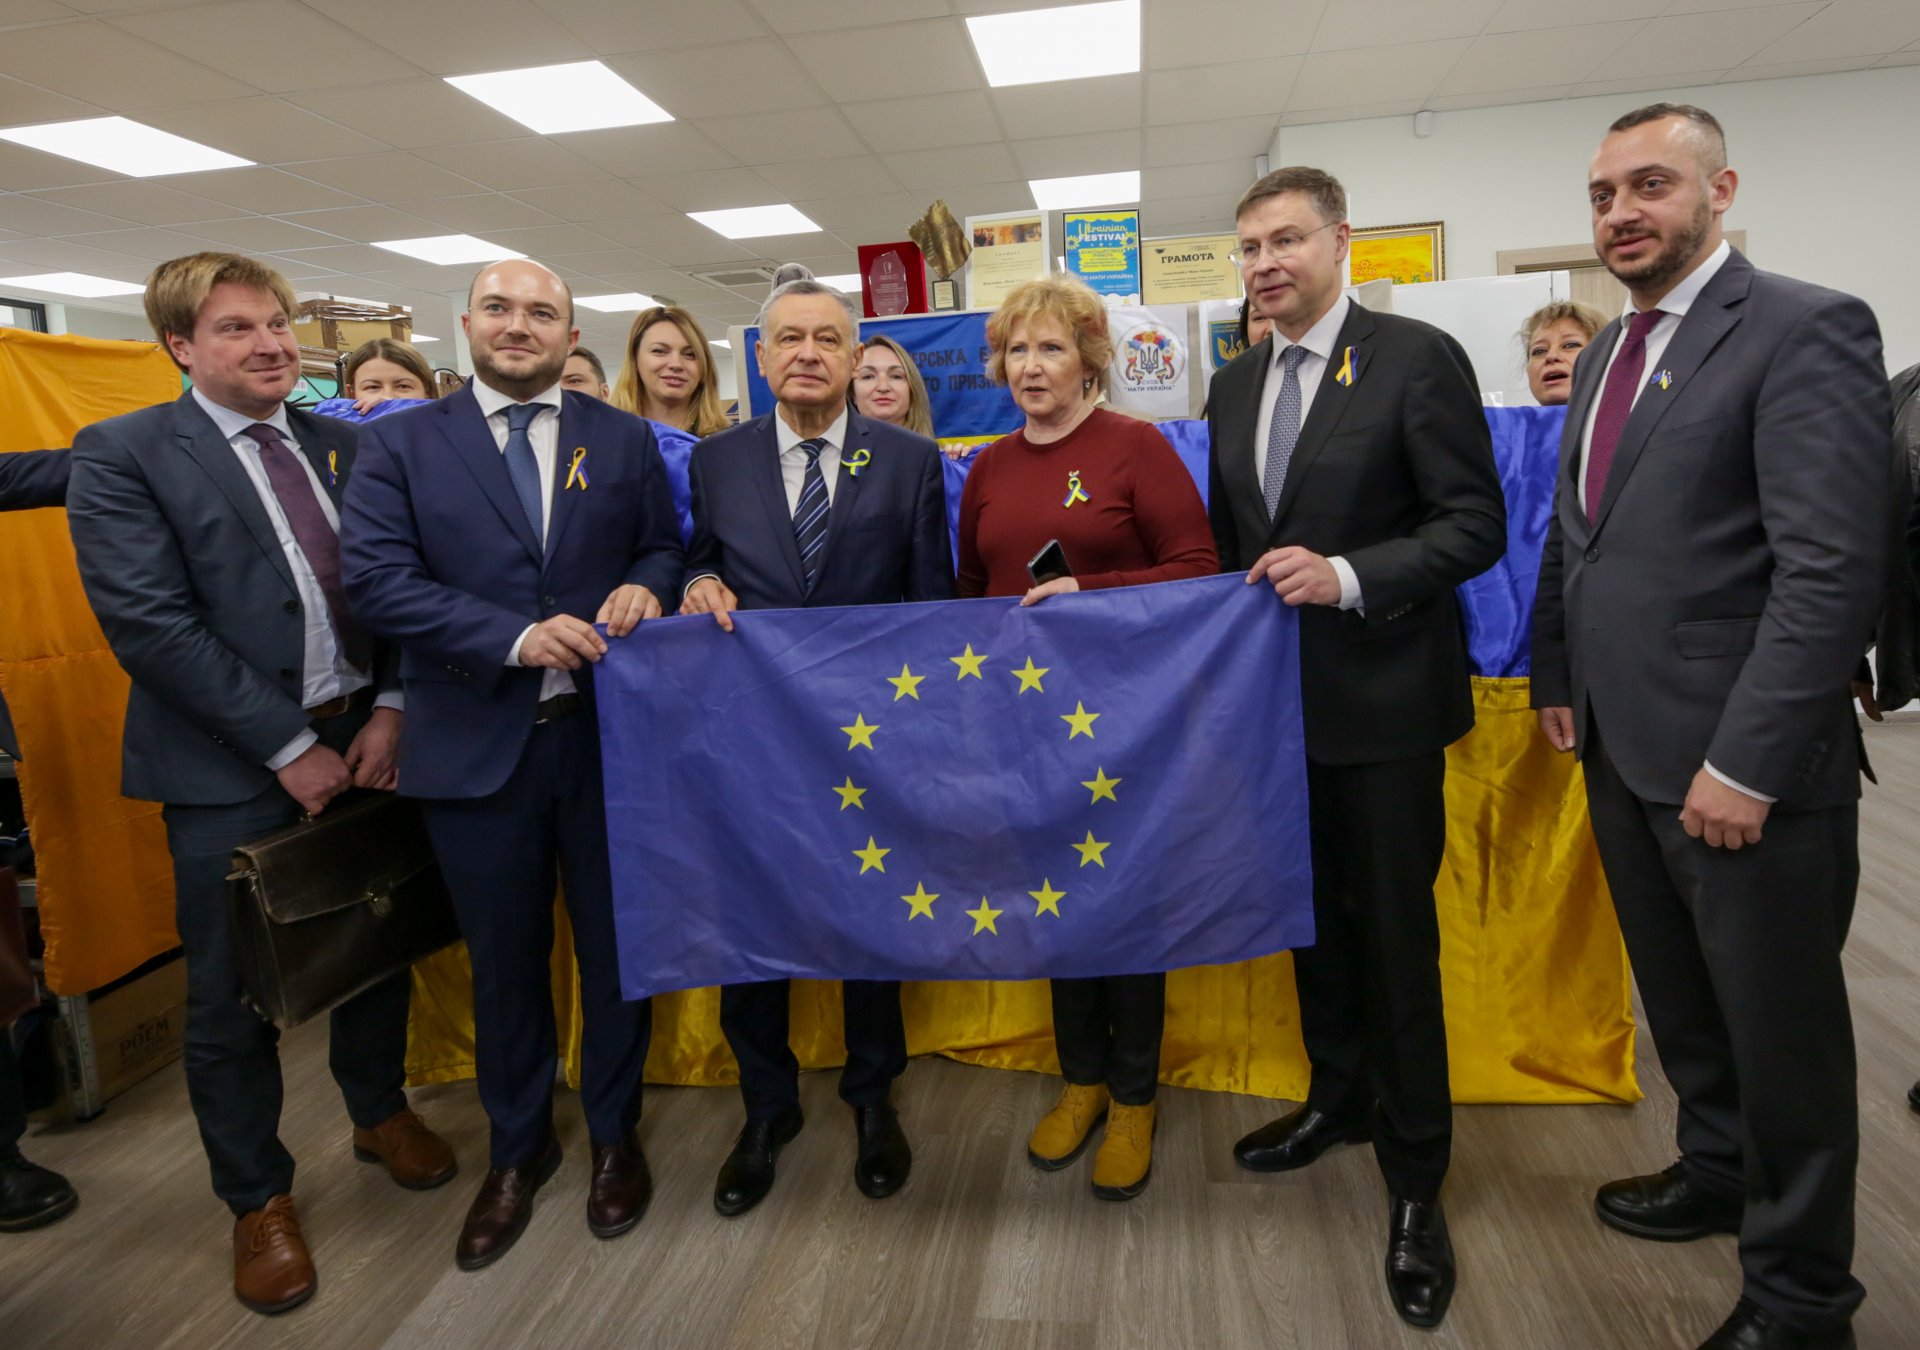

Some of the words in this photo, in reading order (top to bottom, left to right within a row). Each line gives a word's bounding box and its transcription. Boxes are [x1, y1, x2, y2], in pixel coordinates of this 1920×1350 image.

[1079, 223, 1129, 236] Ukrainian
[1161, 252, 1215, 264] ГРАМОТА
[911, 348, 968, 369] ЕРСЬКА
[120, 1018, 169, 1056] POEM
